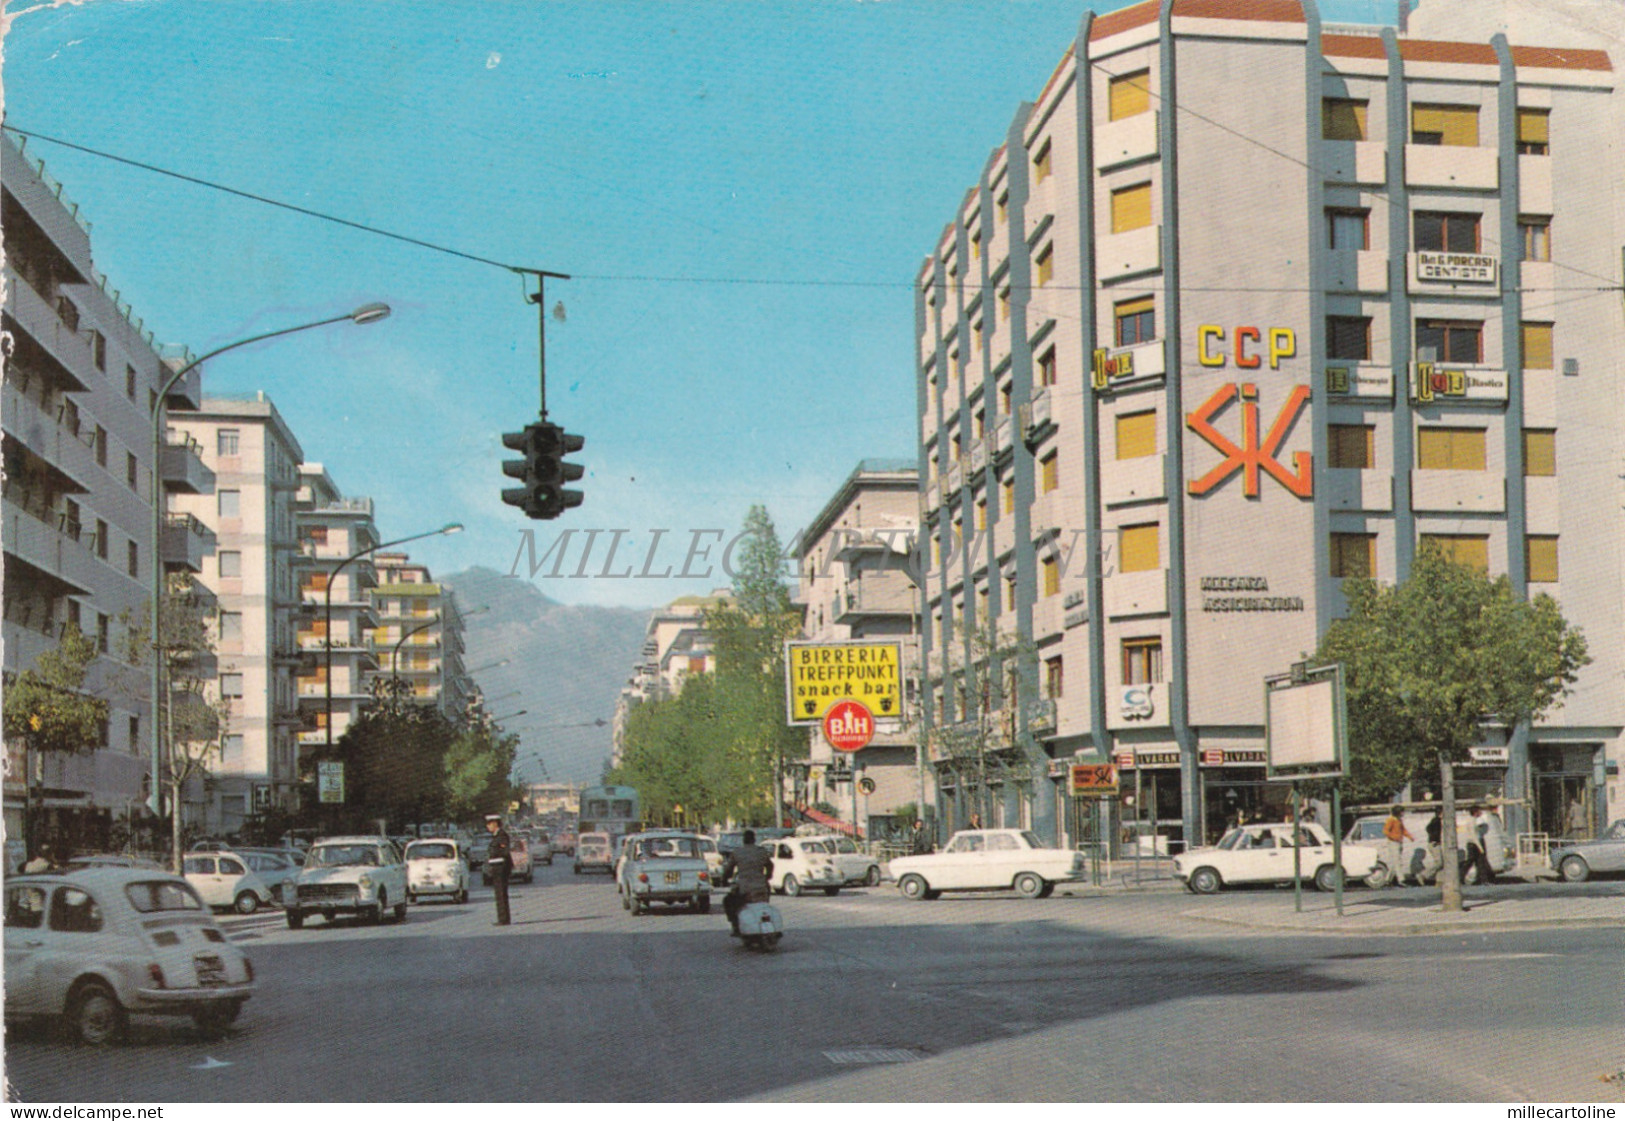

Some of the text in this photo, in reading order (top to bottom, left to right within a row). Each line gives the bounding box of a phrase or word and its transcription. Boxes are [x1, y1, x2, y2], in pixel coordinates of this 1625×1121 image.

[1426, 266, 1487, 277] DENTISTA
[1199, 325, 1297, 370] CCP
[802, 648, 889, 664] BIRRERIA
[798, 664, 896, 681] TREFFPUNKT
[797, 682, 897, 697] snack bar
[1204, 749, 1267, 766] SALVARAN
